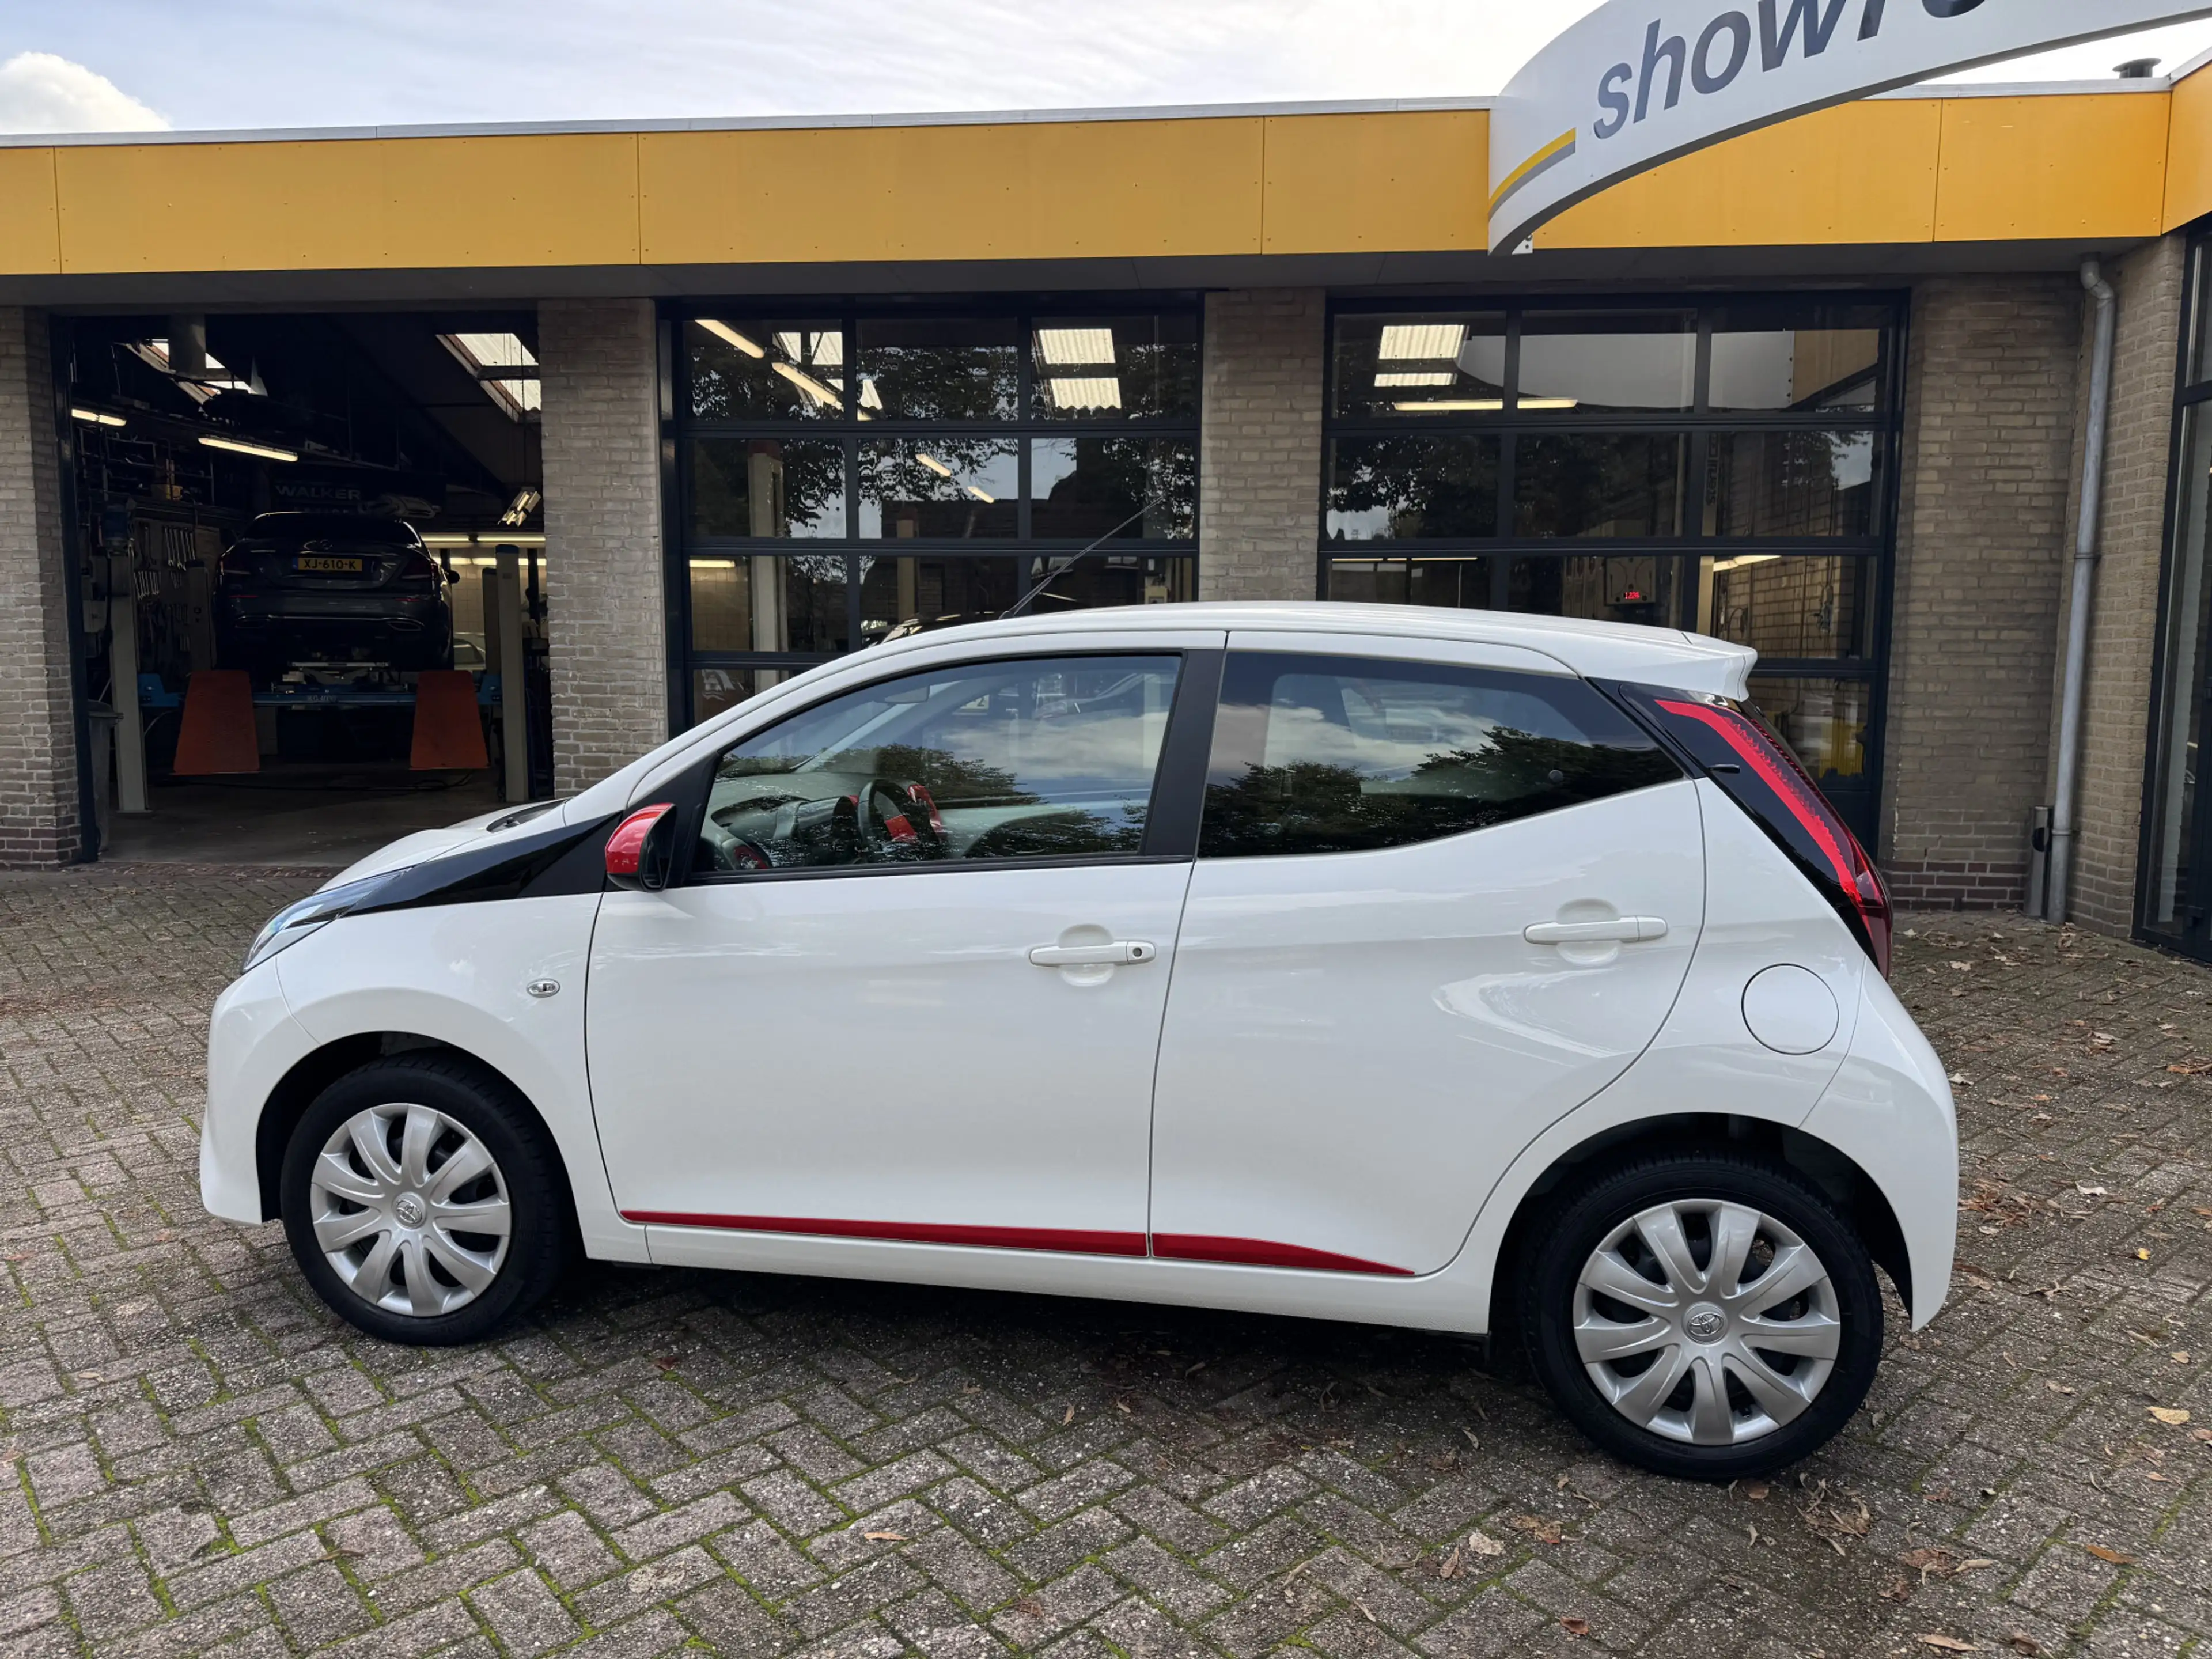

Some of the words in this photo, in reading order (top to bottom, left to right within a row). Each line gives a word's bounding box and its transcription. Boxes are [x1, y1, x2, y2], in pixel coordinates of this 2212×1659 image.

[1593, 0, 1986, 139] show
[275, 484, 361, 501] WALKER
[304, 559, 357, 570] XJ-610-K
